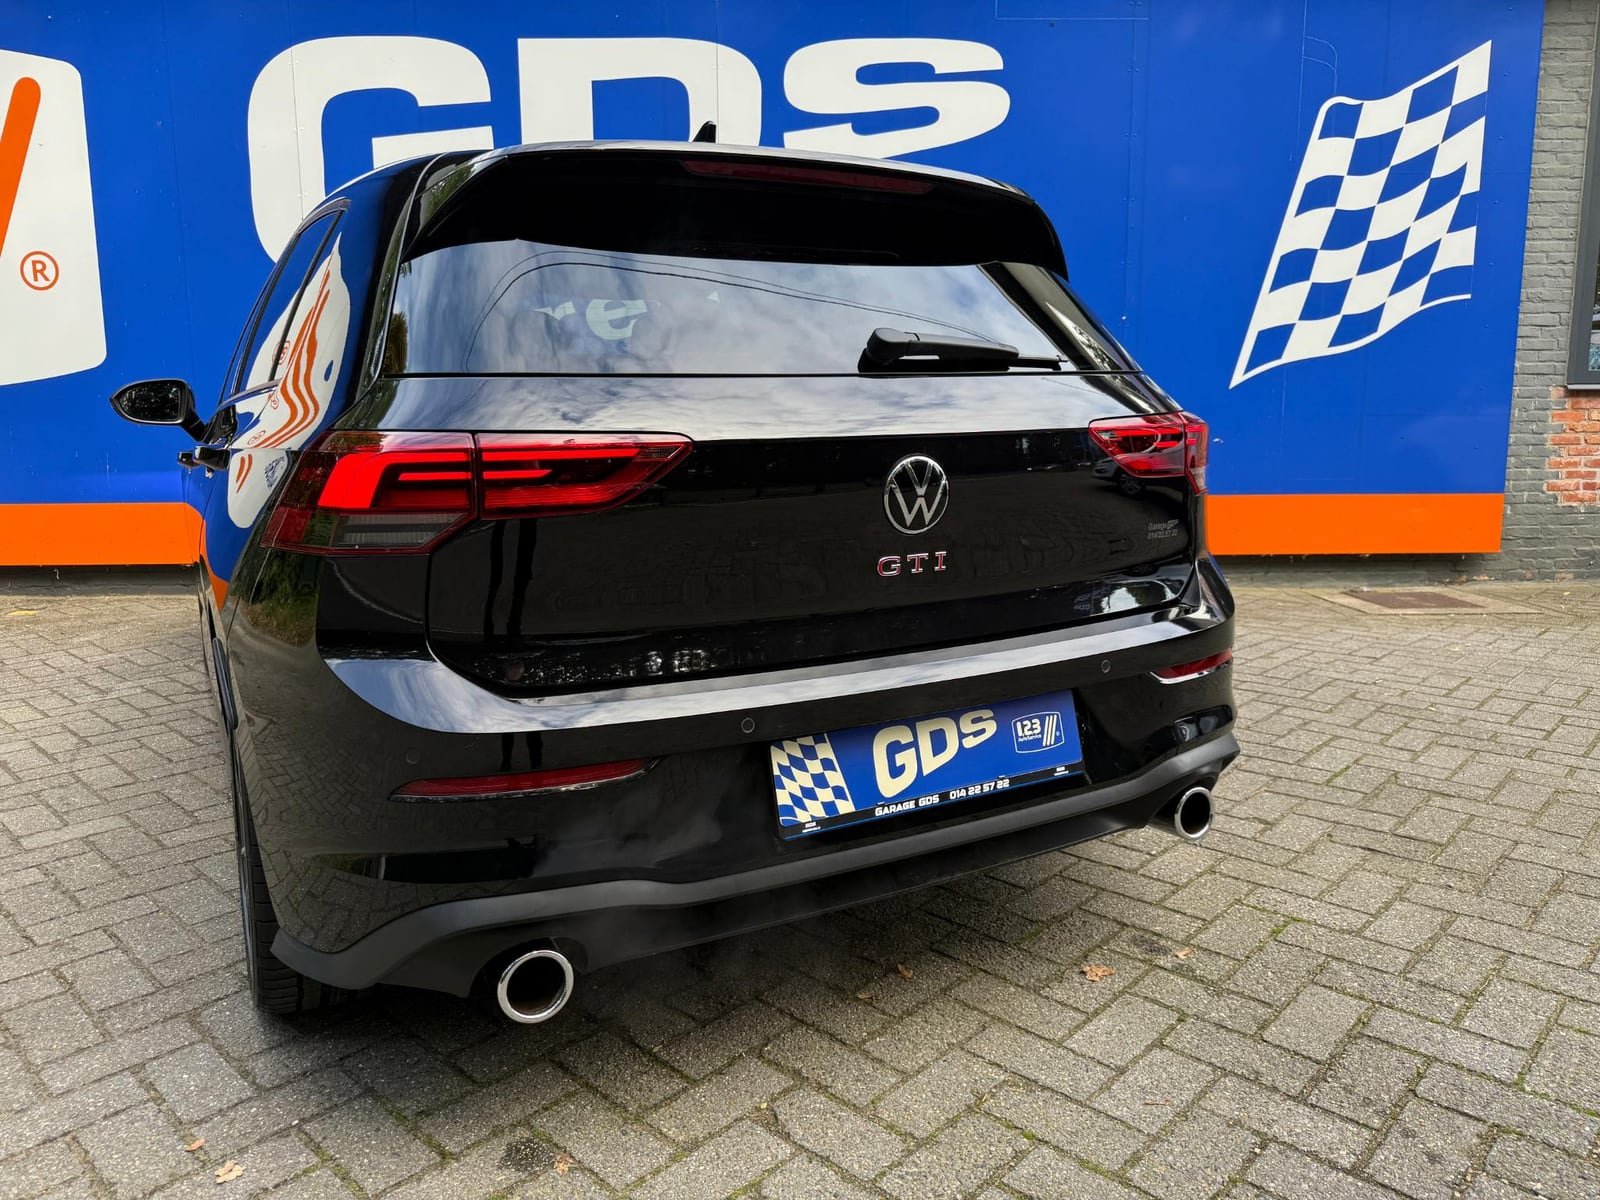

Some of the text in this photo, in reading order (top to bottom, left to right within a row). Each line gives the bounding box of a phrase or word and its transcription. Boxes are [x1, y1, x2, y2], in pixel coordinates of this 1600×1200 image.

[247, 36, 1011, 262] GDS
[877, 551, 947, 577] GTI
[873, 709, 998, 798] GDS
[875, 778, 1010, 816] GARAGE GDS 014 22 57 22
